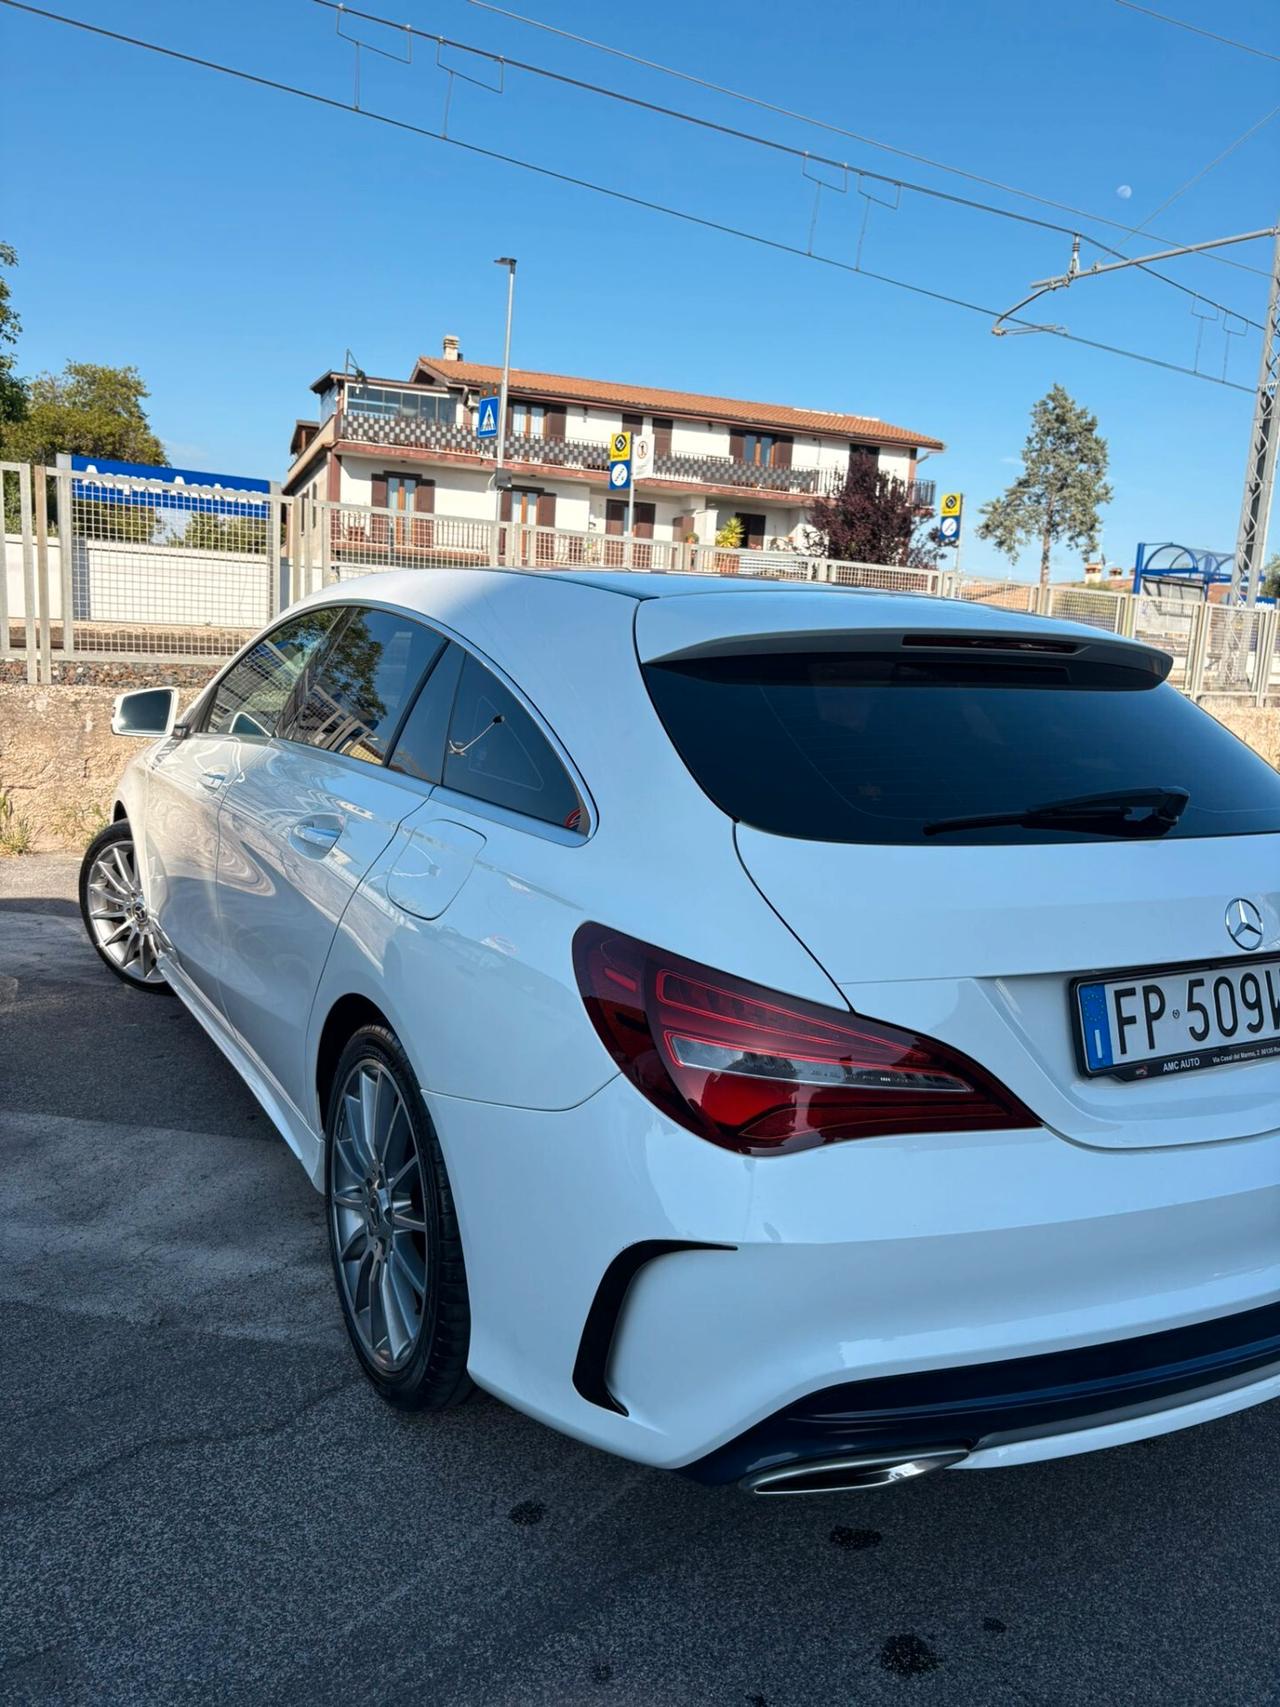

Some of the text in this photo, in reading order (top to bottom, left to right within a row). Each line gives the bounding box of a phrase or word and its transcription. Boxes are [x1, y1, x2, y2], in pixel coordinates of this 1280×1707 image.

[1113, 984, 1166, 1055] FP
[1094, 1029, 1103, 1059] I
[1162, 1057, 1200, 1072] AMC AUTO
